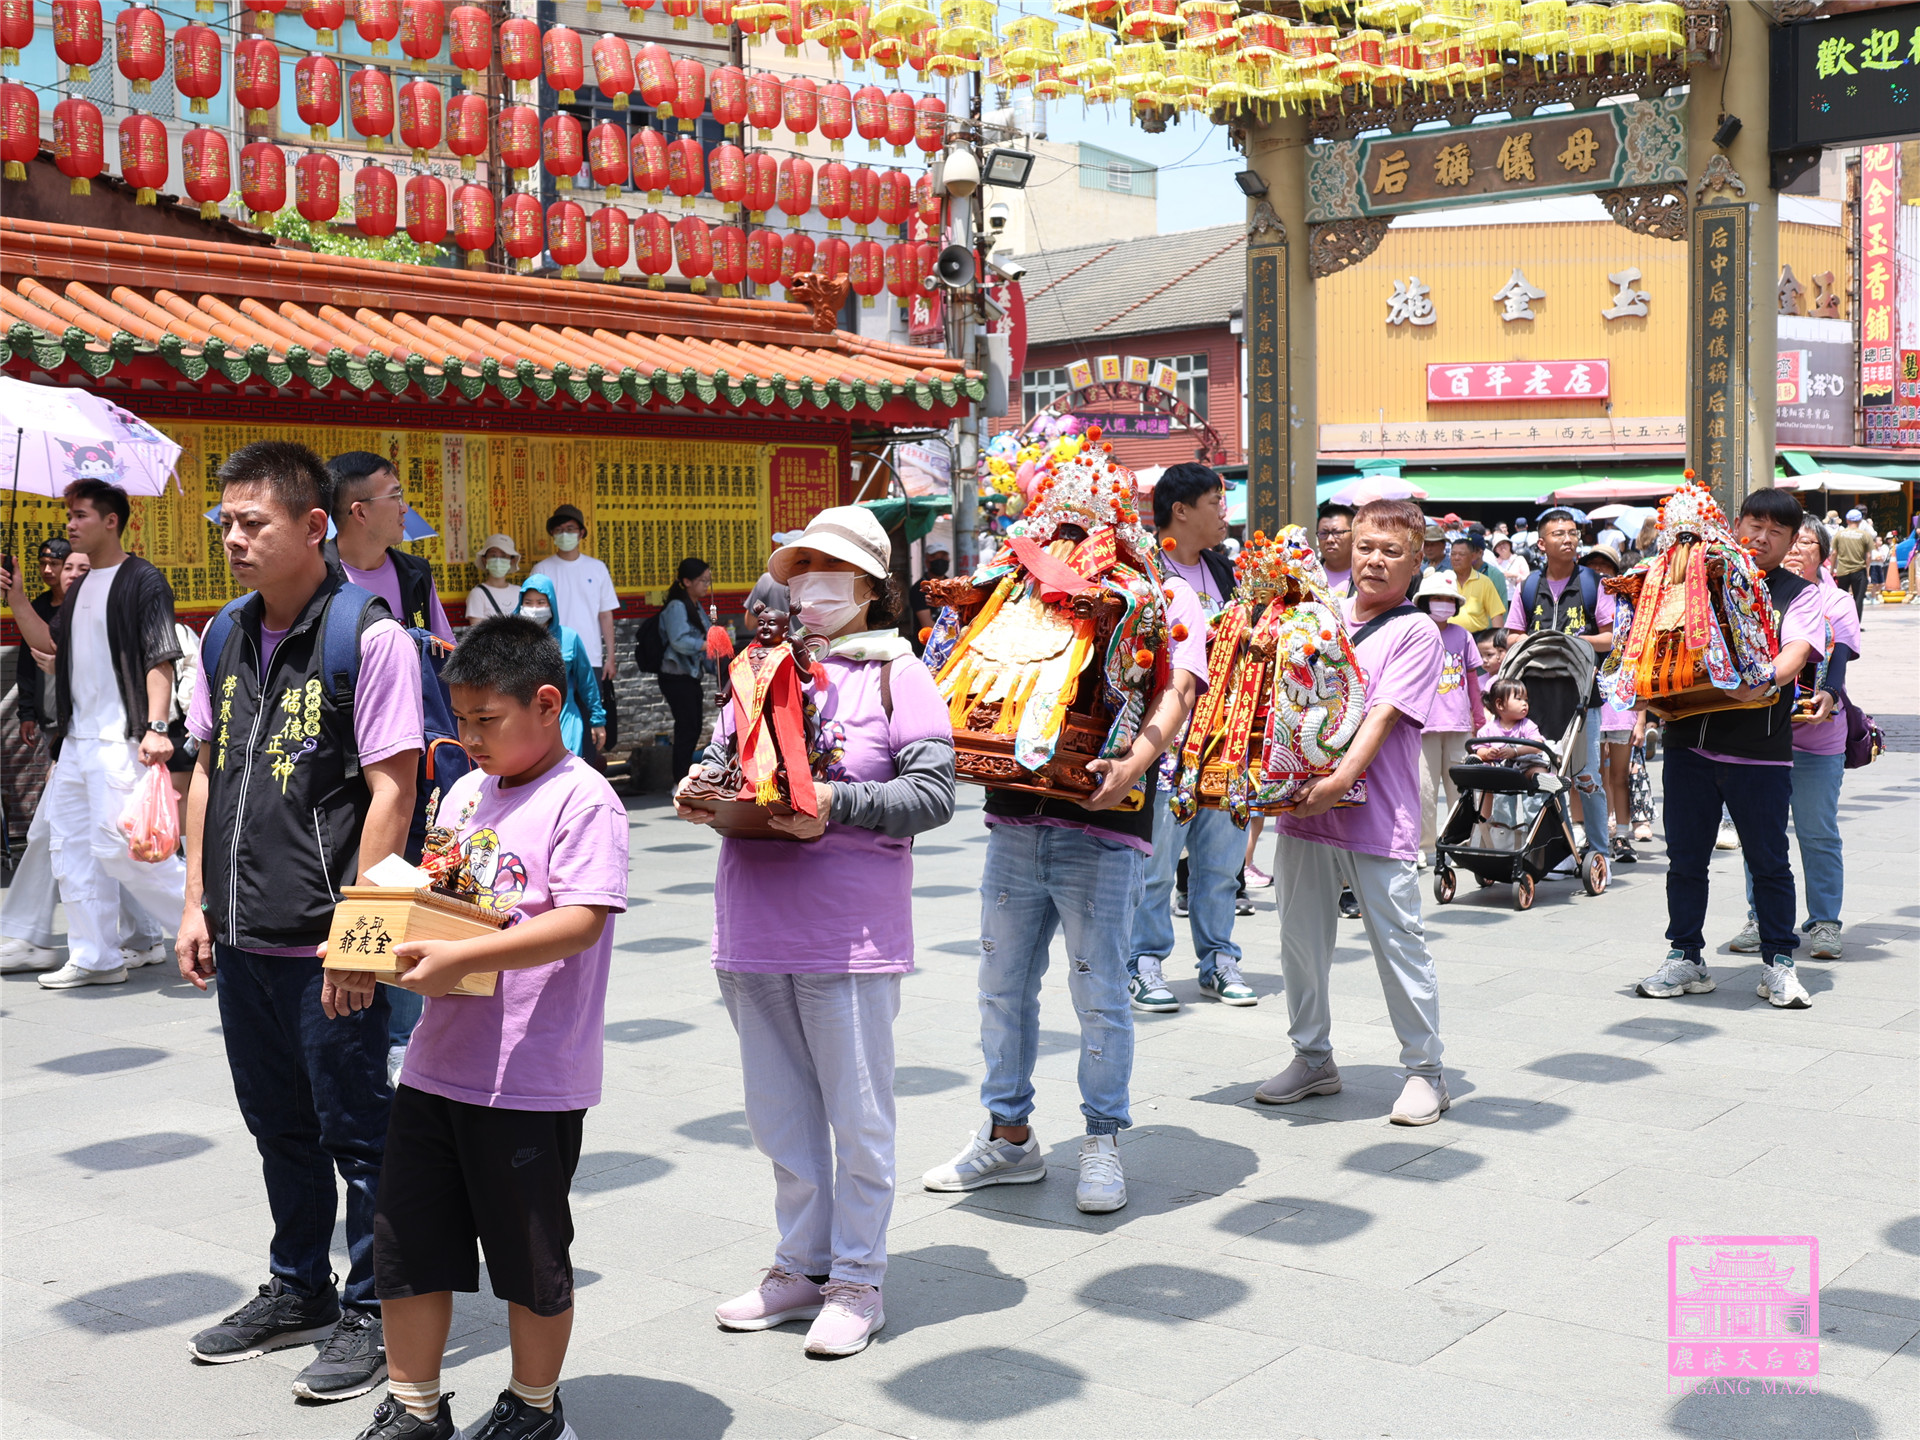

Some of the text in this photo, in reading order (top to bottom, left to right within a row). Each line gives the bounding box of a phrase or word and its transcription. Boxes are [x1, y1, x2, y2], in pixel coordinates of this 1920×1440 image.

[1444, 365, 1593, 397] 百年老店
[1863, 366, 1893, 383] 百年老店
[216, 675, 238, 771] 榮譽委員
[265, 687, 305, 795] 福德正神
[1231, 691, 1252, 755] 合境平安
[515, 1148, 538, 1158] NIKE
